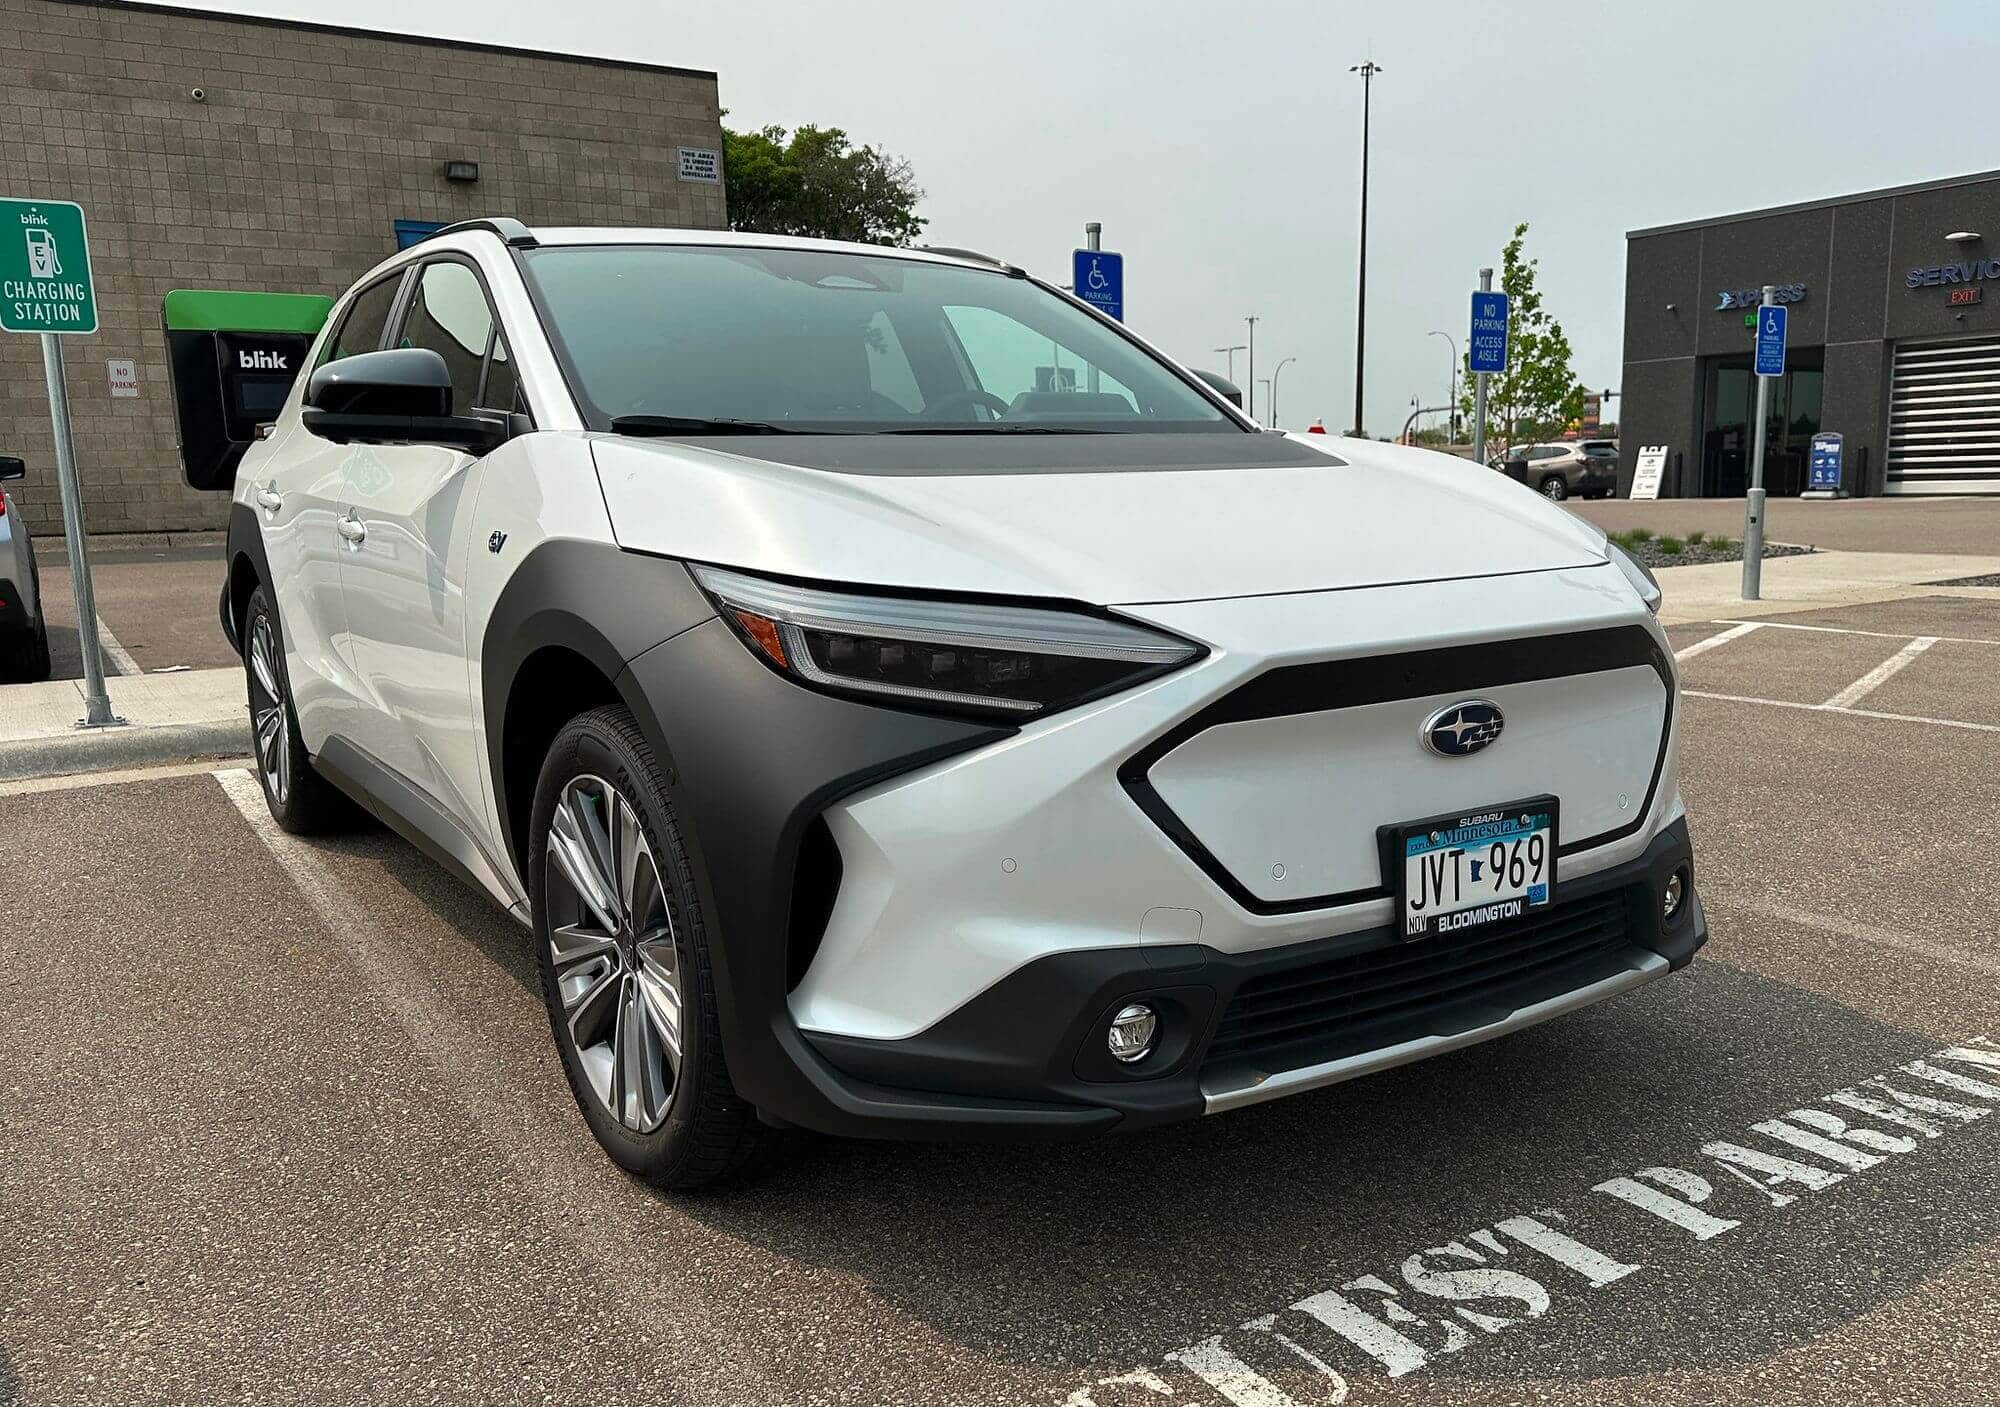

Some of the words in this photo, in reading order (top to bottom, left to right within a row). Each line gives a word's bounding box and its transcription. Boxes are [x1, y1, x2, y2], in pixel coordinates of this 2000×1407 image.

[20, 213, 48, 225] blink
[4, 280, 85, 300] CHARGING
[1084, 291, 1113, 302] PARKING
[1951, 288, 1977, 304] EXIT
[15, 302, 81, 321] STATION
[1484, 304, 1496, 317] NO
[1474, 318, 1505, 331] PARKING
[1475, 335, 1503, 348] ACCESS
[239, 350, 288, 369] blink
[1478, 350, 1498, 361] AISLE
[116, 367, 128, 377] NO
[111, 380, 137, 390] PARKING
[1459, 812, 1504, 828] SUBARU
[1411, 848, 1466, 911] JVT
[1489, 833, 1545, 893] 969
[1438, 900, 1522, 933] BLOOMINGTON
[1408, 915, 1427, 934] NOV
